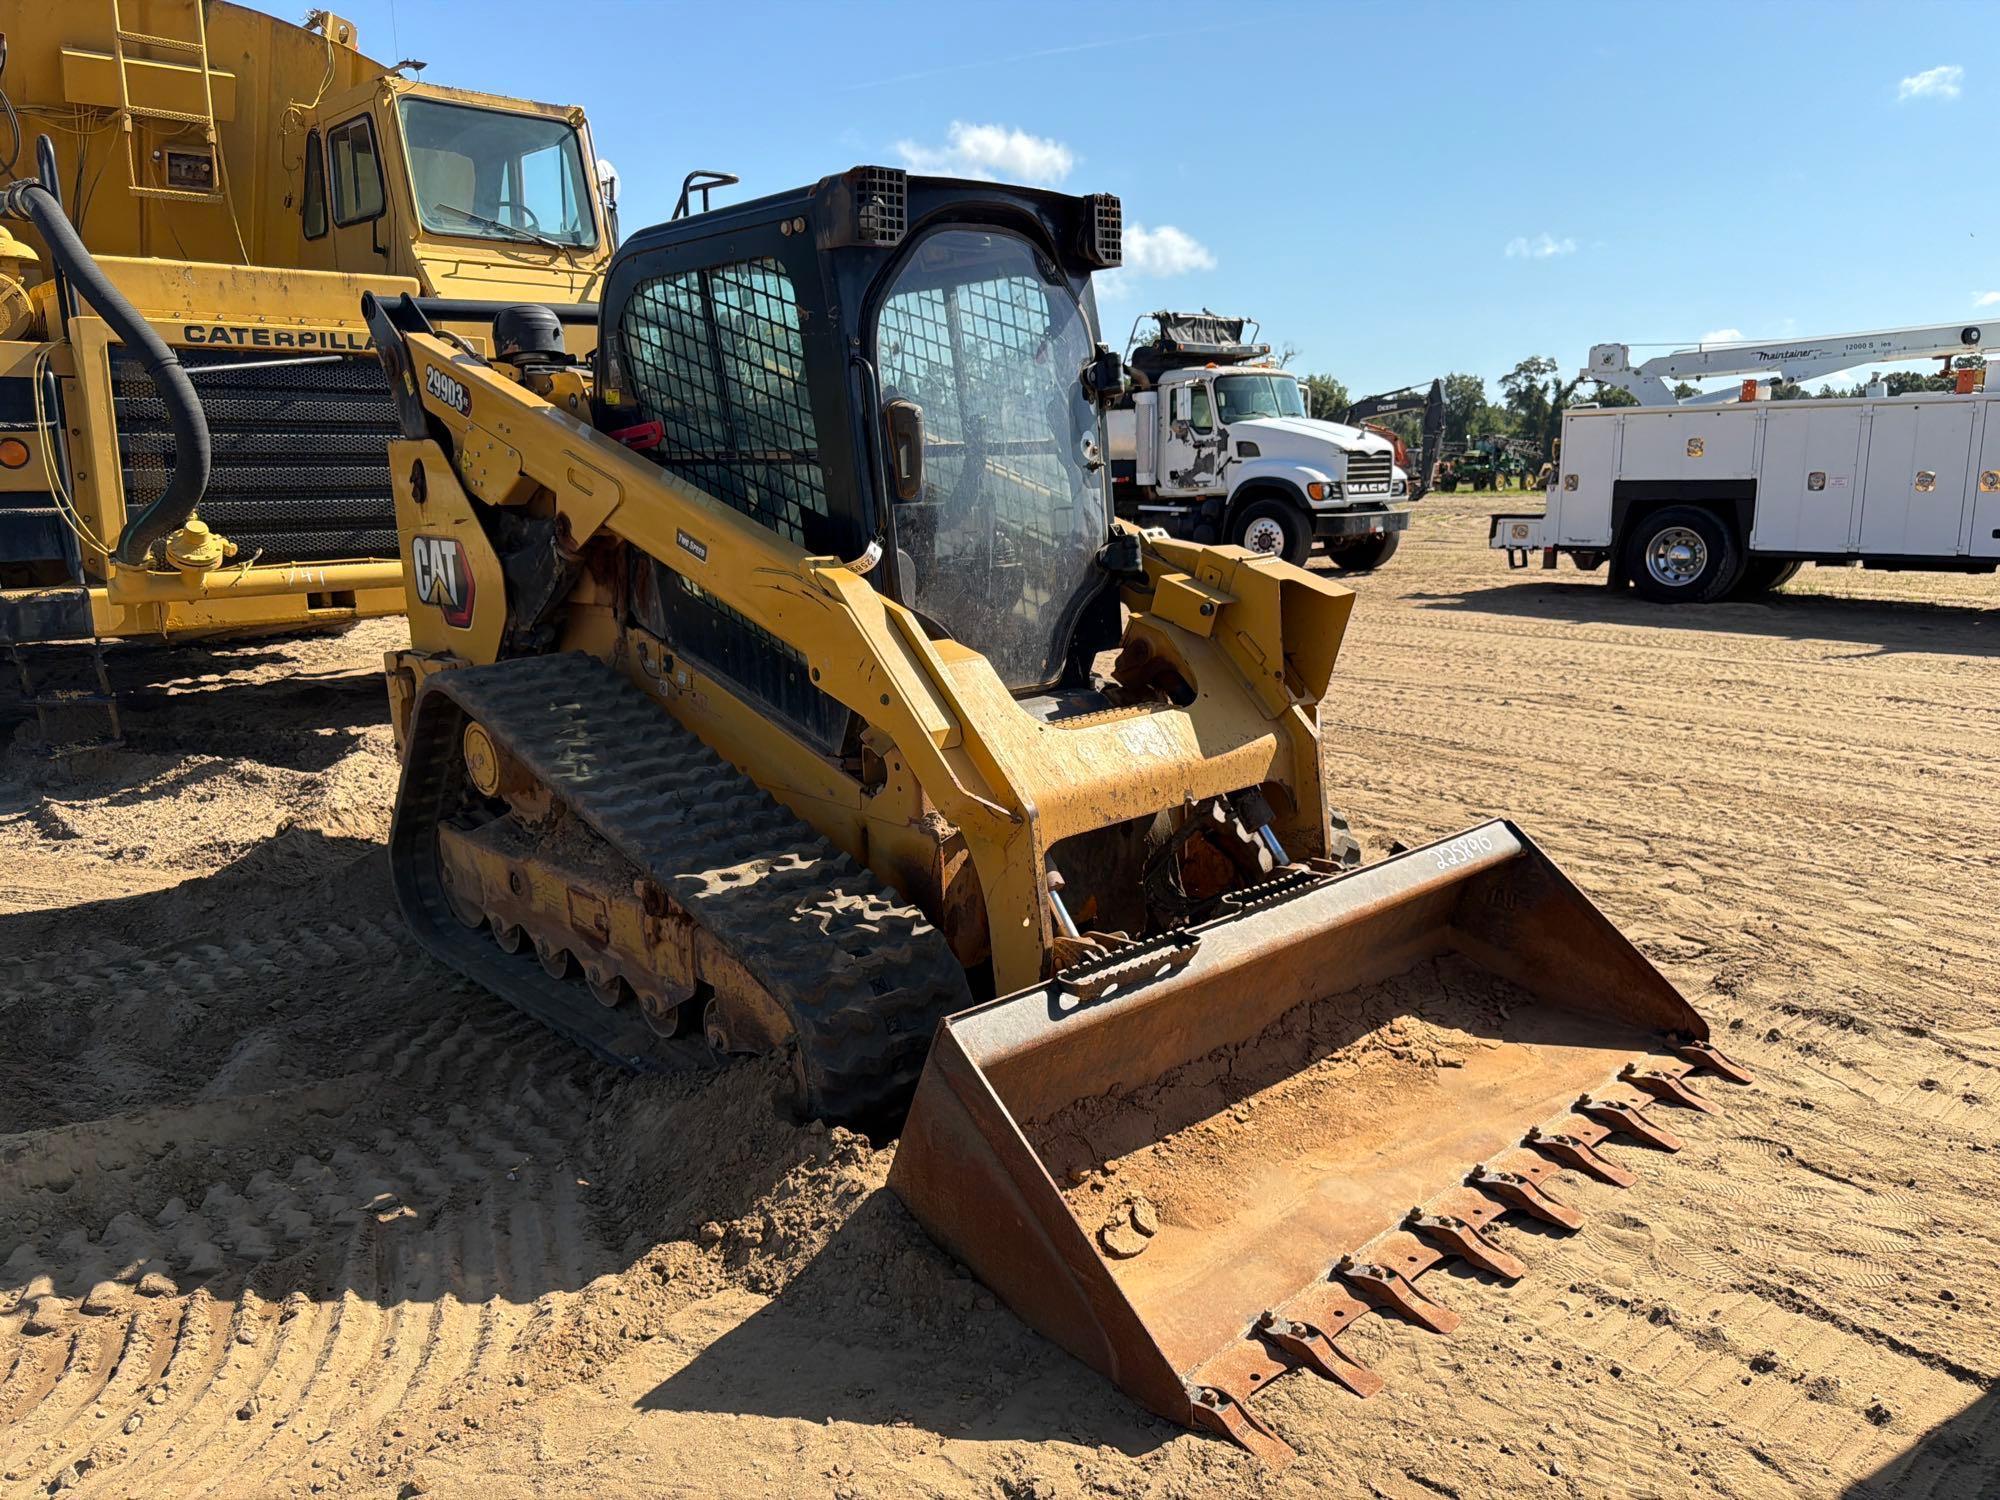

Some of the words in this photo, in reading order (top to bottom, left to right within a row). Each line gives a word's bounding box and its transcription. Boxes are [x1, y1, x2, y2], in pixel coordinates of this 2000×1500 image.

[184, 325, 377, 350] CATERPILLA
[1869, 341, 1891, 349] Sies
[1755, 349, 1816, 361] Maintainer
[427, 366, 463, 411] 299D3
[1348, 483, 1388, 492] MACK
[413, 537, 458, 605] CAT
[850, 553, 877, 573] 22589
